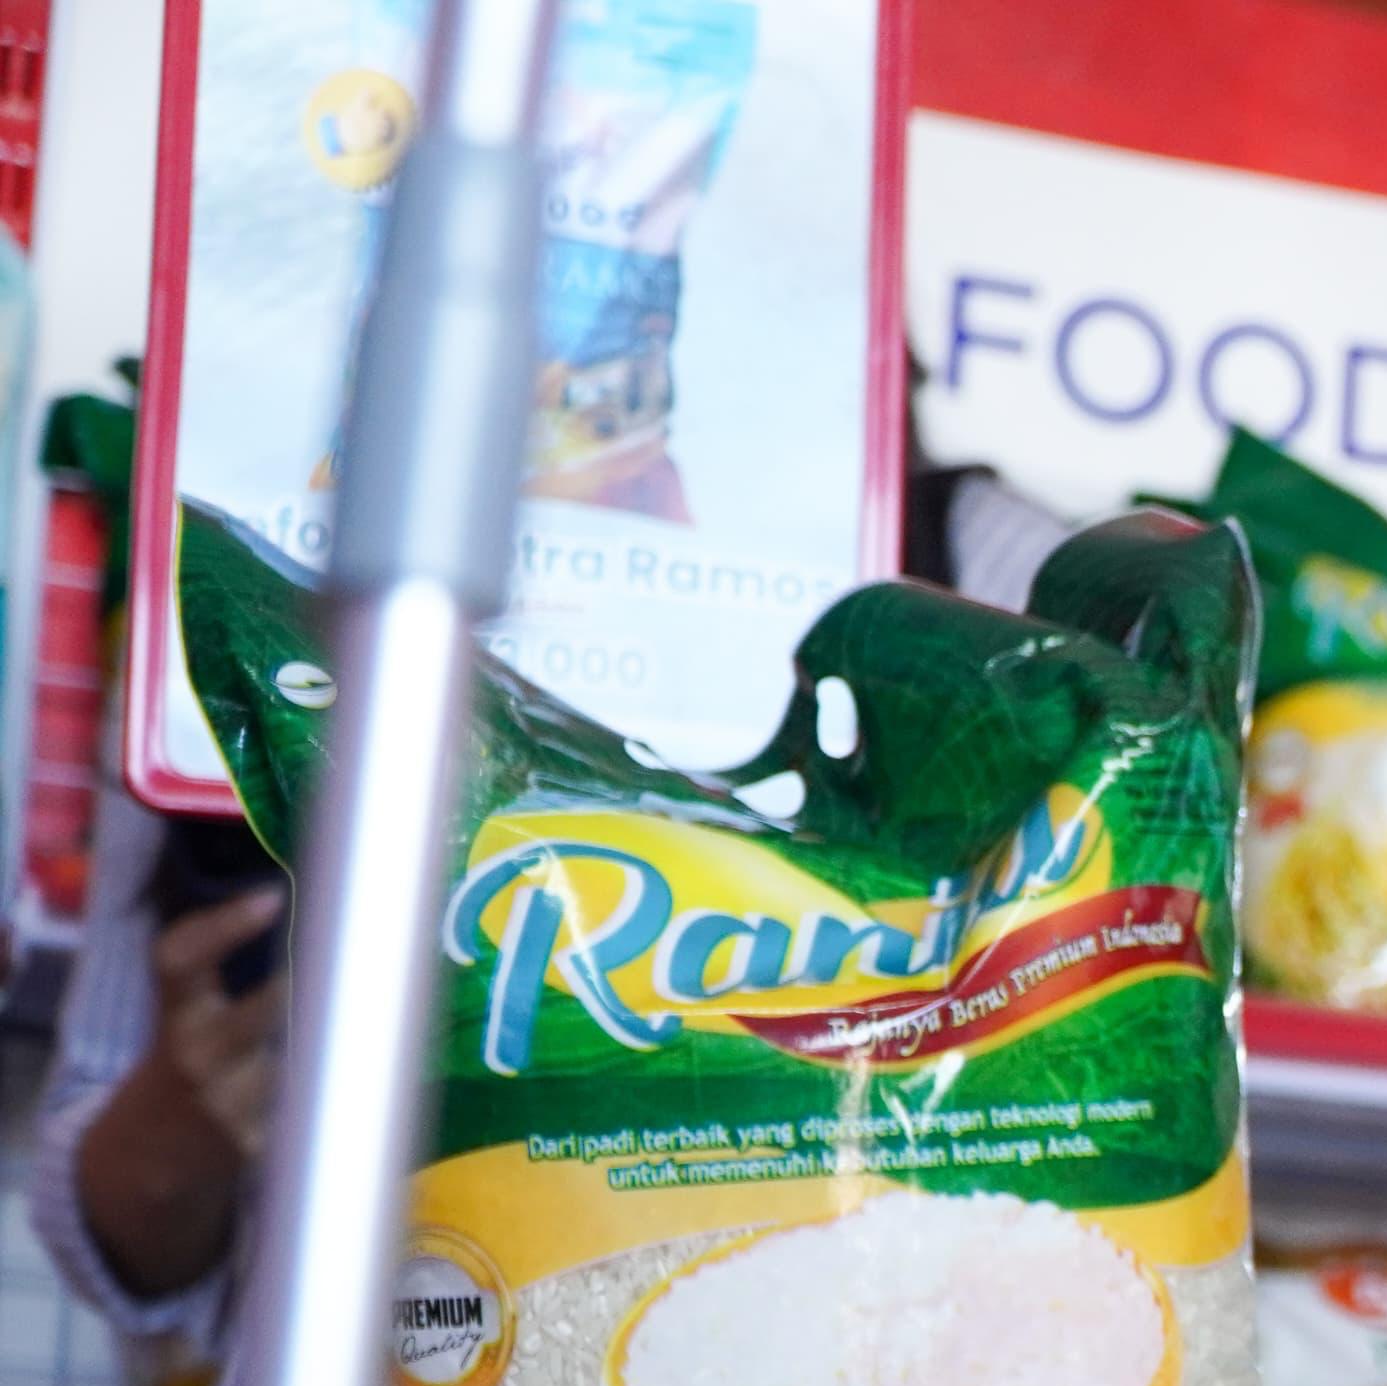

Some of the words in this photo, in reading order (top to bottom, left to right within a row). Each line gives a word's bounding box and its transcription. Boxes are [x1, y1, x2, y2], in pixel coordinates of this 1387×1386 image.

[529, 1133, 576, 1160] Dari
[582, 1128, 635, 1162] padi
[643, 1124, 730, 1154] terbaik
[737, 1122, 794, 1152] yang
[608, 1160, 680, 1188] untuk
[684, 1152, 813, 1184] memenuhi
[392, 1297, 483, 1329] PREMIUM
[400, 1331, 485, 1369] Quality
